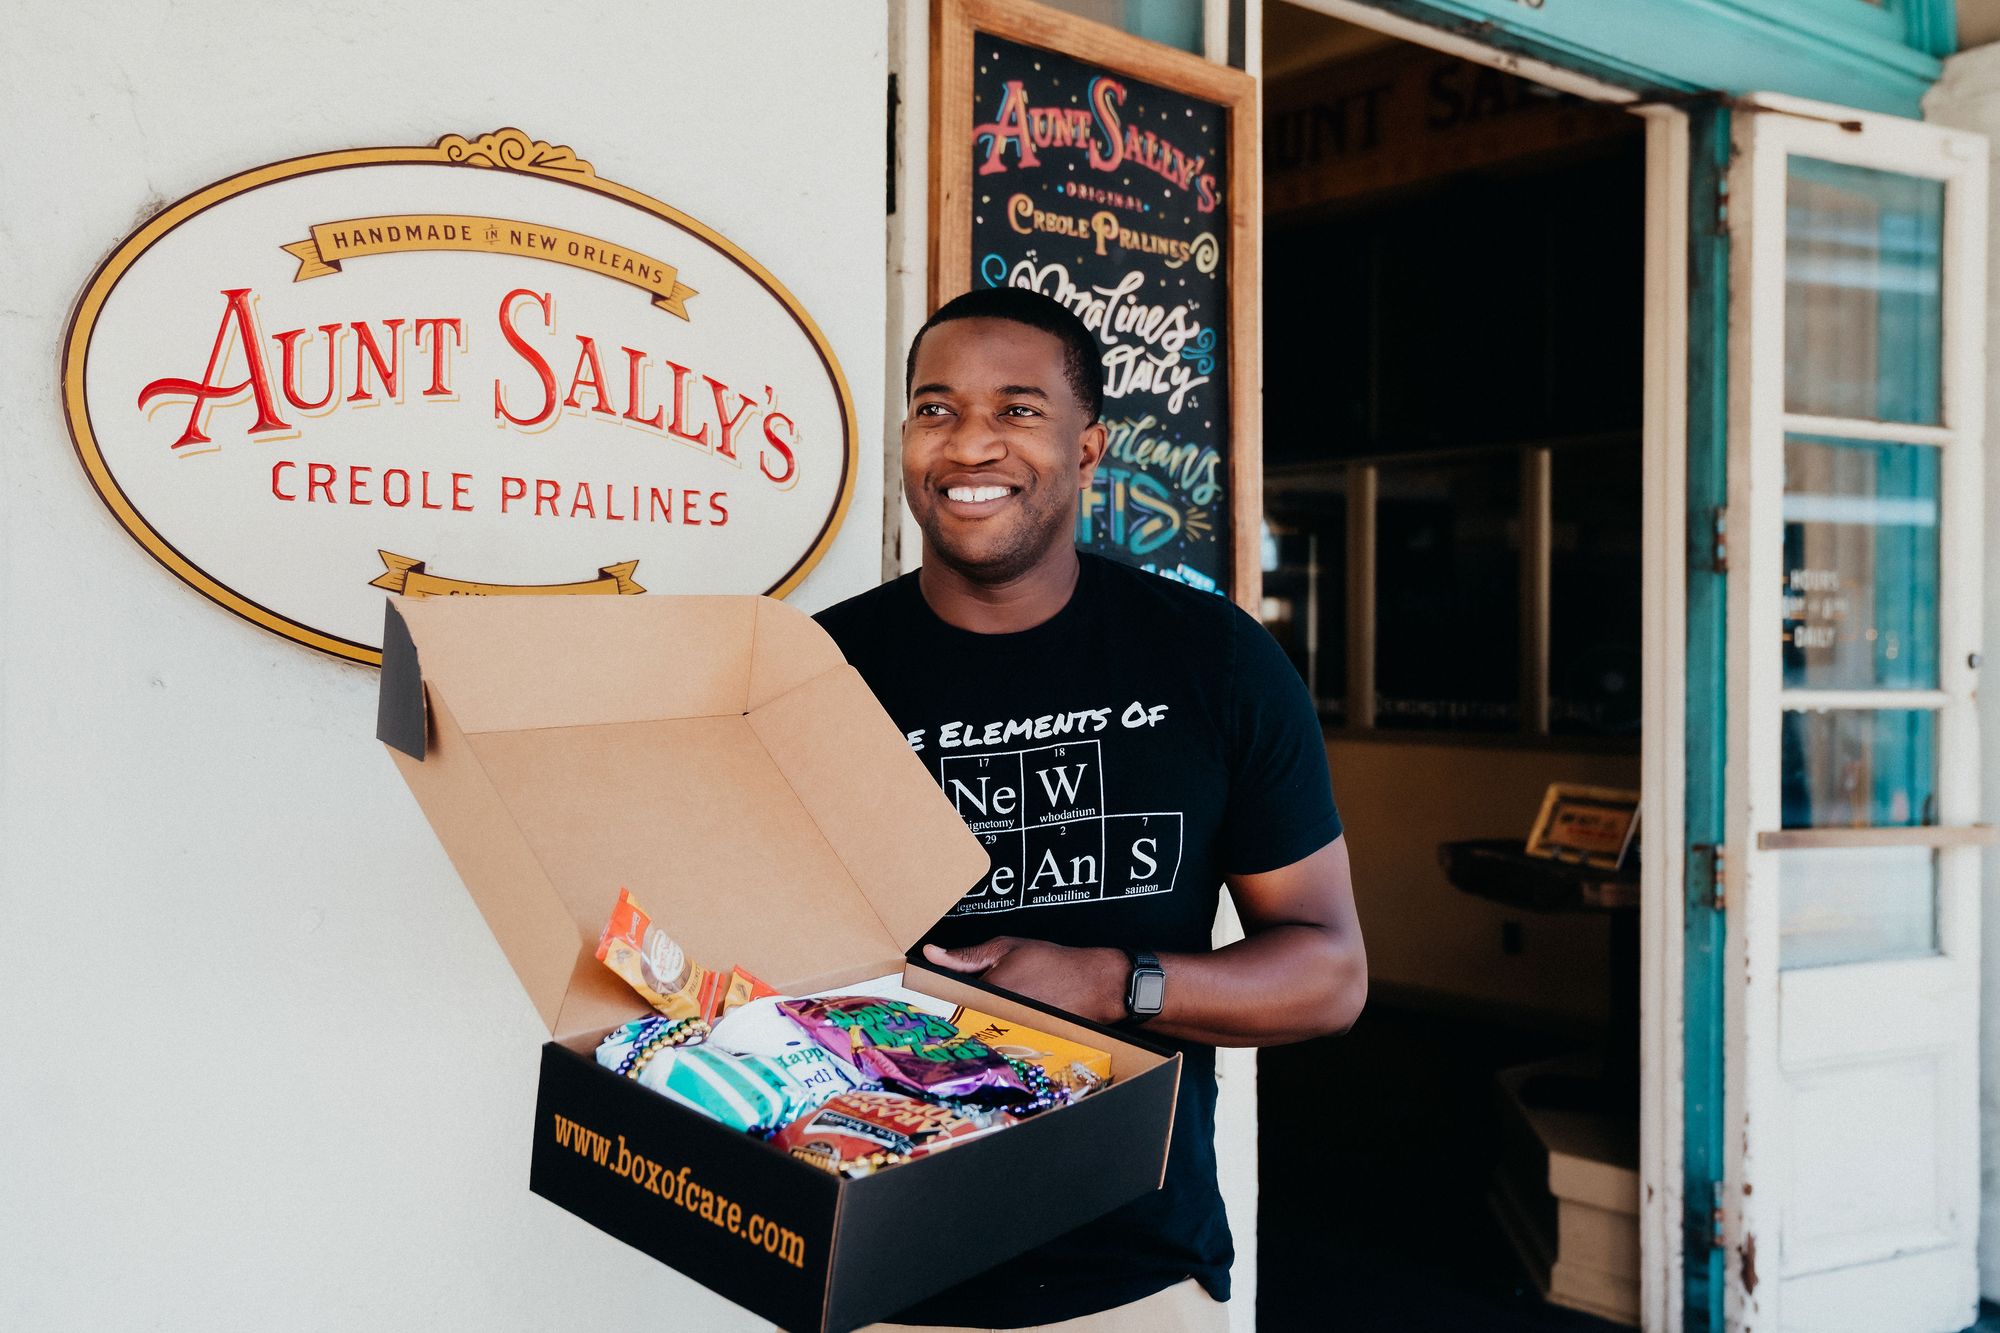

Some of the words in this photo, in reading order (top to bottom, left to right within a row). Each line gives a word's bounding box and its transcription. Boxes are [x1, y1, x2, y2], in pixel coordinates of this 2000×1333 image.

[1065, 180, 1145, 213] ORIGINAL
[332, 224, 472, 249] HANDMADE
[485, 228, 498, 242] IN
[510, 229, 557, 251] NEW
[568, 241, 665, 284] ORLEANS
[138, 287, 465, 454] AUNT
[1103, 414, 1222, 506] rleans
[271, 460, 474, 512] CREOLE
[500, 476, 731, 527] PRALINES
[938, 706, 1112, 749] ELEMENTS
[1120, 700, 1169, 729] OF
[978, 758, 990, 768] 17
[1053, 746, 1066, 758] 18
[947, 775, 1017, 818] Ne
[1034, 763, 1088, 808] W
[967, 818, 1015, 832] ignetomy
[1038, 805, 1097, 823] whodatium
[1059, 825, 1067, 836] 2
[1142, 816, 1149, 827] 7
[984, 834, 997, 845] 29
[1026, 848, 1099, 891] An
[1129, 837, 1158, 881] S
[1031, 888, 1091, 904] andouilline
[1124, 881, 1159, 896] sainton
[803, 1068, 833, 1089] rdi
[553, 1113, 806, 1269] www.boxofcare.com
